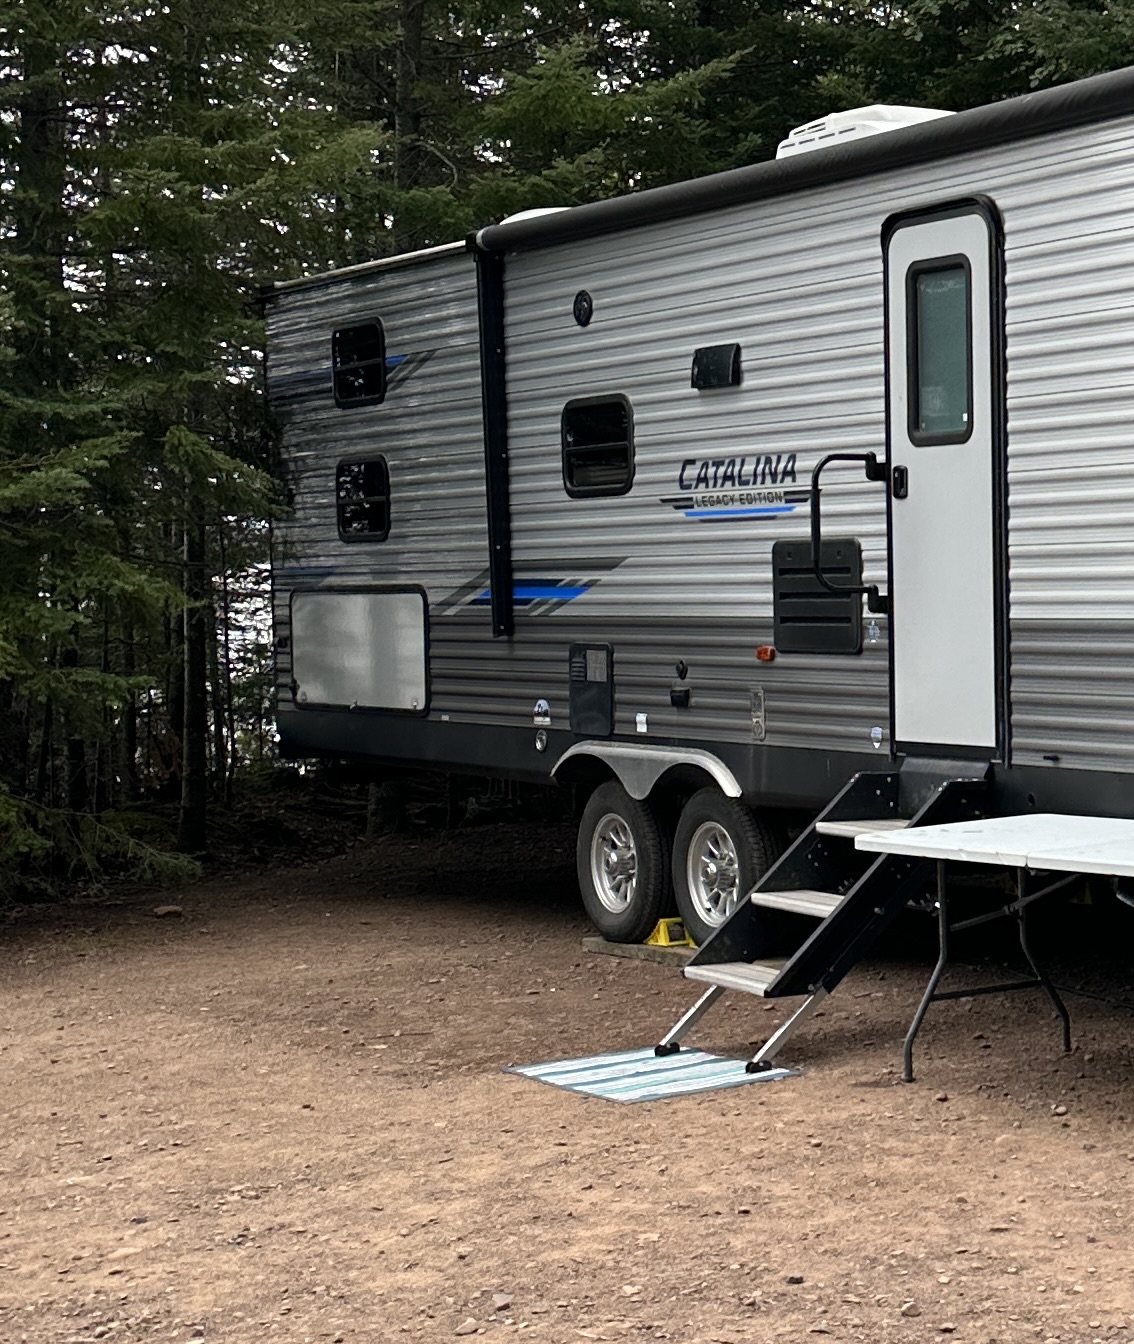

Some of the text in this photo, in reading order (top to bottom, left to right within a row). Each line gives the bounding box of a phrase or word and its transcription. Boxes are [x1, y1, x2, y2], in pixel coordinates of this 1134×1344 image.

[678, 453, 797, 491] CATALINA
[694, 491, 783, 508] LEGACY EDITION
